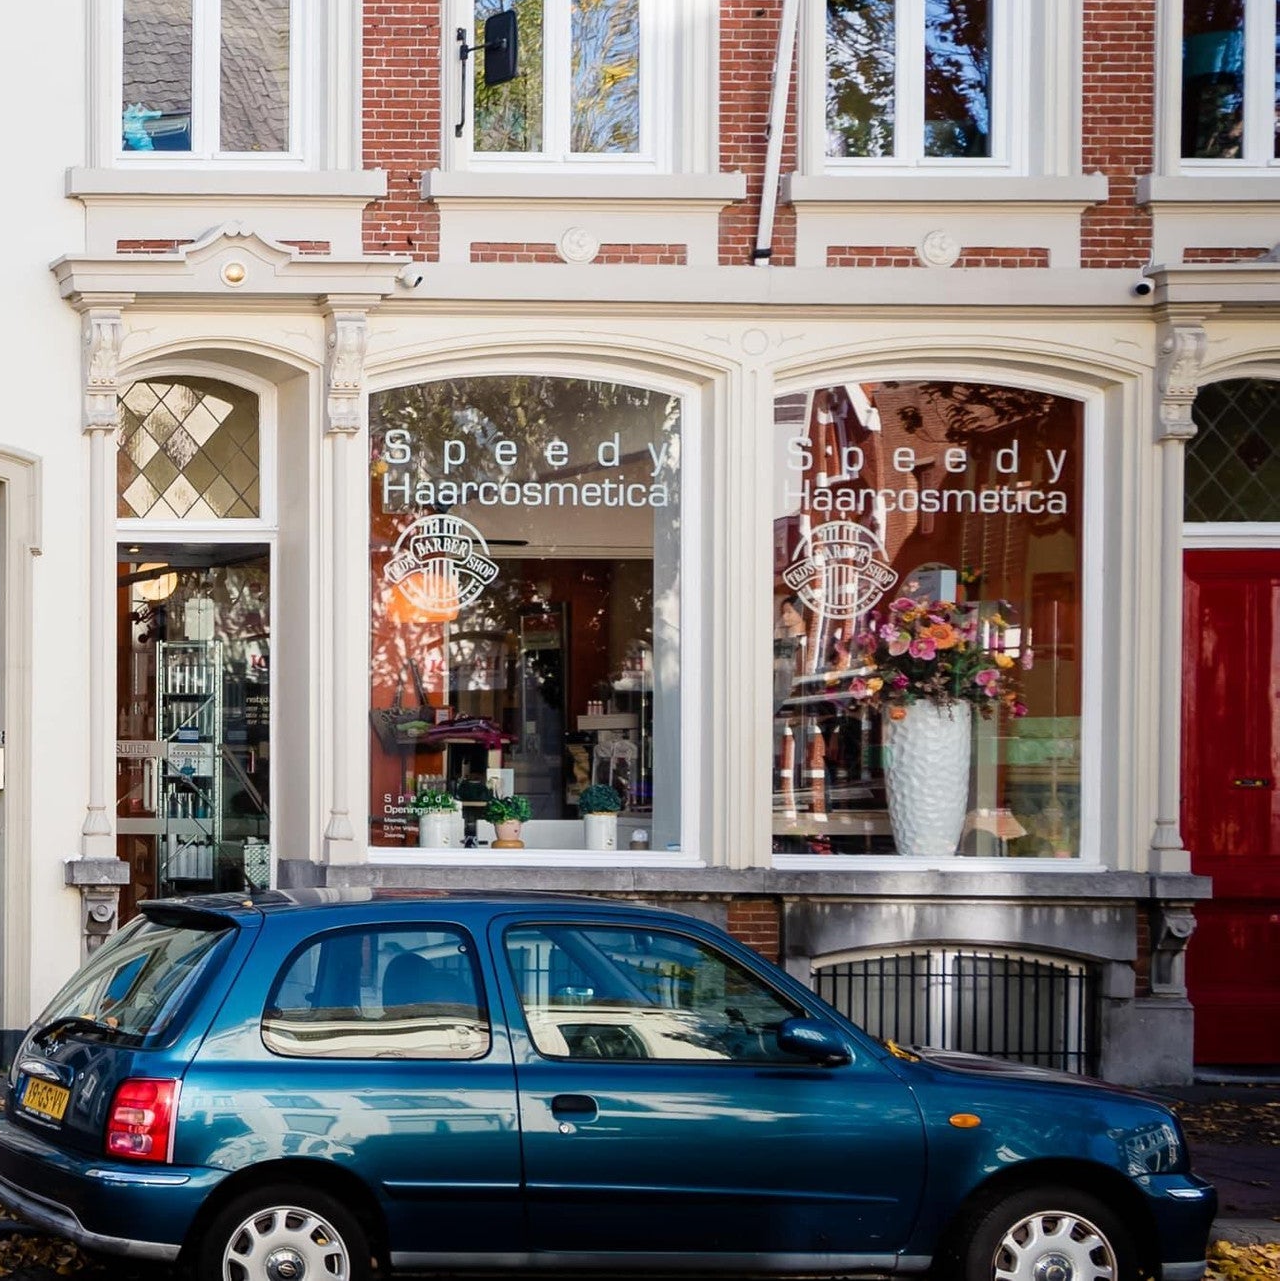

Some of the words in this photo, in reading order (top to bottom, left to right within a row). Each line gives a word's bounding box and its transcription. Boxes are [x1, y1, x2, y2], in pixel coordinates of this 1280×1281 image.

[384, 428, 668, 477] Speedy
[787, 436, 1067, 483] Speedy
[382, 471, 669, 508] Haarcosmetica
[784, 478, 1068, 515] Haarcosmetica
[414, 536, 469, 558] BARBER
[466, 555, 495, 579] SHOP
[866, 562, 895, 586] SHOP
[384, 793, 453, 805] Speedy
